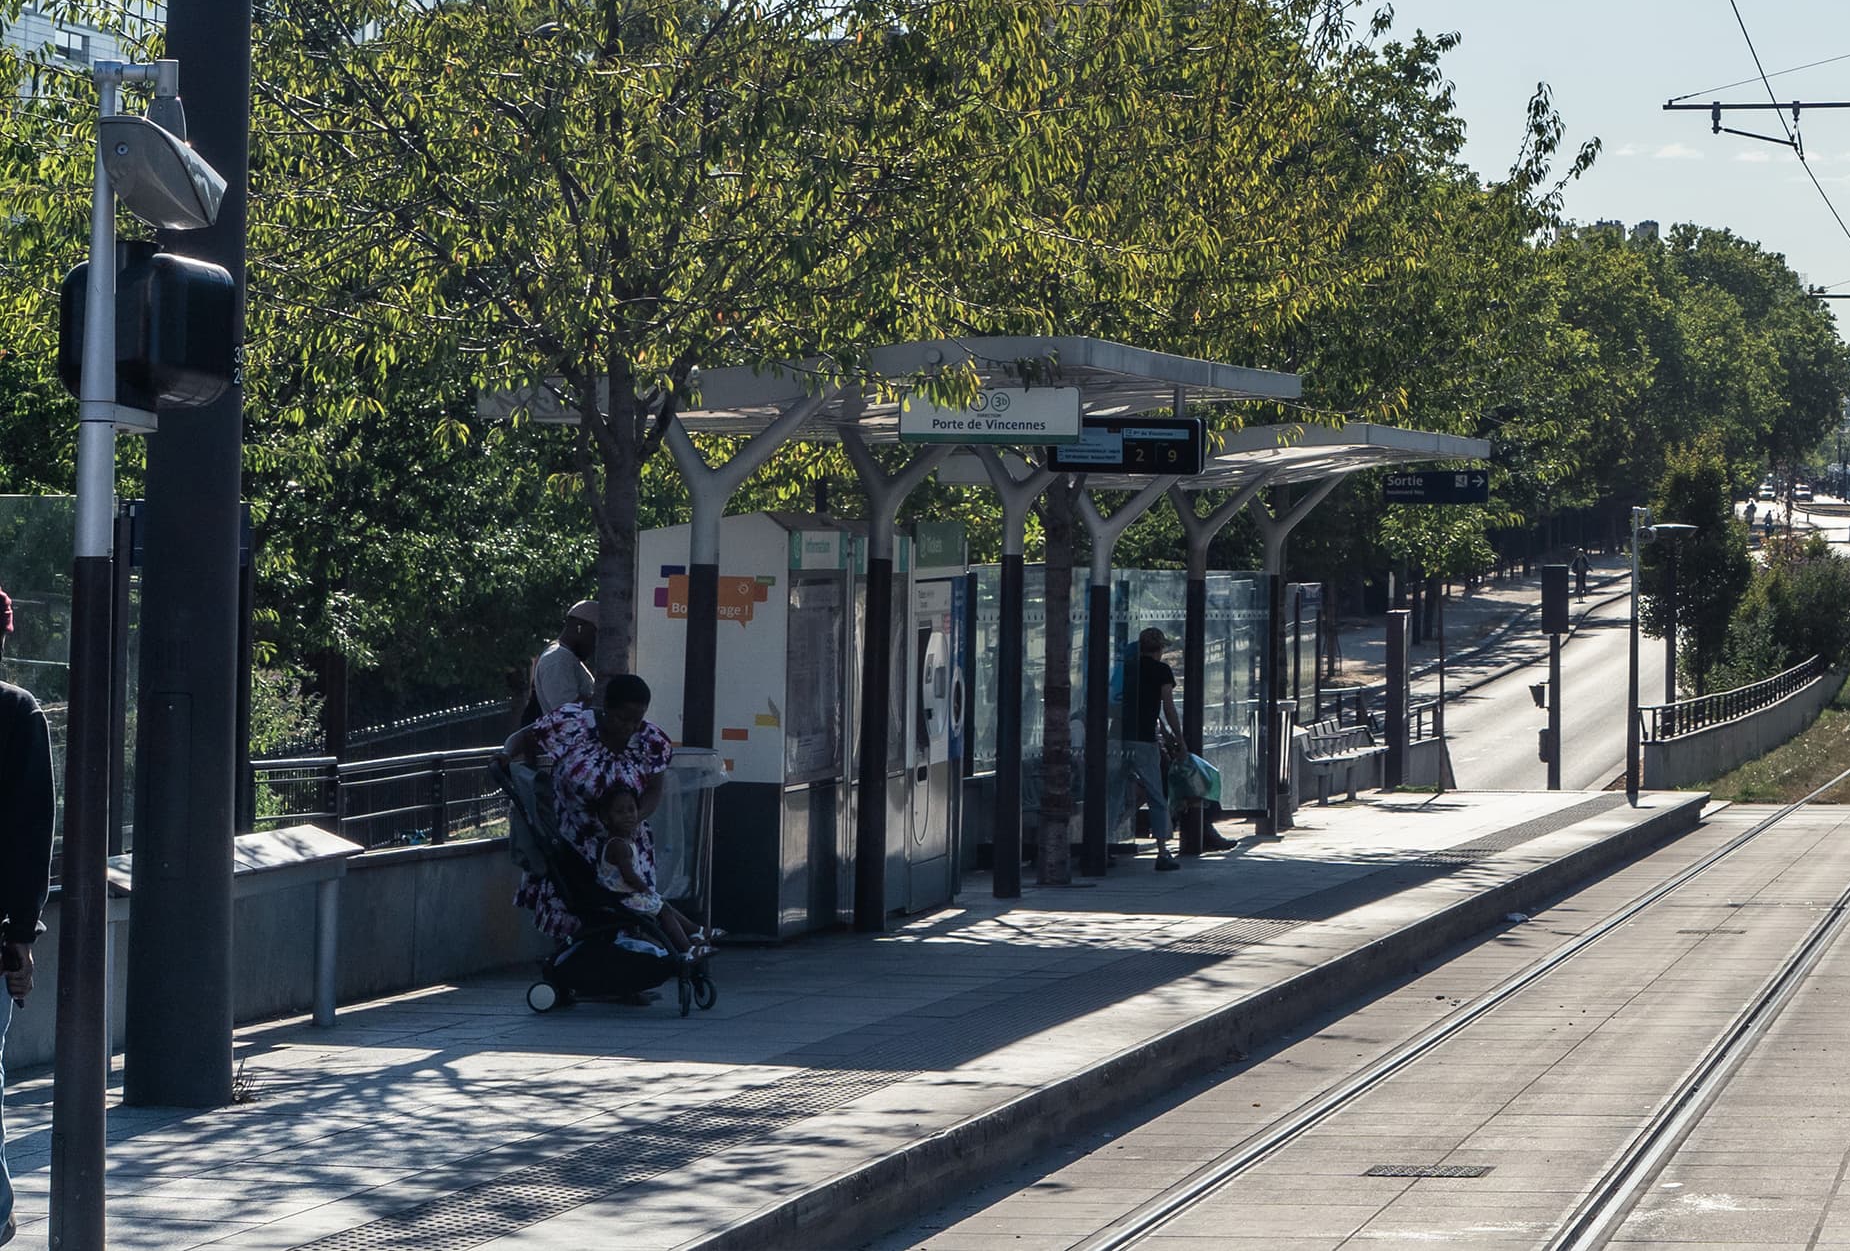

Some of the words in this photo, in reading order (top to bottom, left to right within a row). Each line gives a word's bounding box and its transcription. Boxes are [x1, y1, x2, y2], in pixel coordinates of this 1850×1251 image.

[932, 419, 964, 430] Porte
[967, 419, 982, 430] de
[986, 419, 1046, 431] Vincennes
[1136, 449, 1145, 462] 2
[1168, 449, 1177, 463] 9
[1387, 475, 1424, 486] Sortie
[671, 603, 687, 613] Bo
